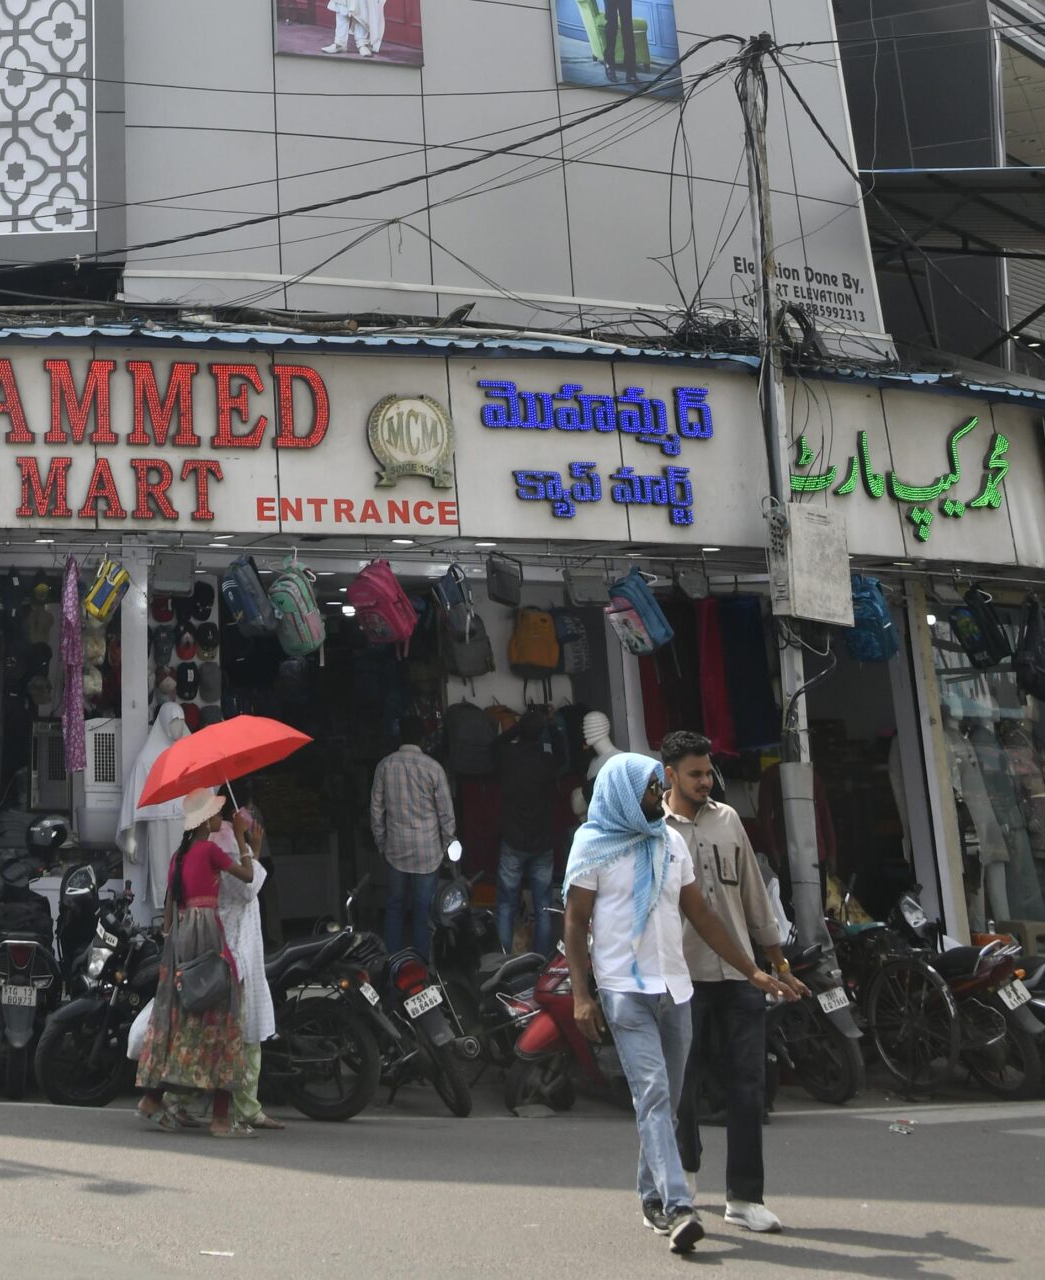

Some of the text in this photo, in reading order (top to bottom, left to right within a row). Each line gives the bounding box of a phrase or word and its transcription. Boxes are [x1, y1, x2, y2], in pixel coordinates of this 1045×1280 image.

[804, 266, 838, 286] Done
[793, 286, 853, 306] ELEVATION
[386, 408, 440, 456] MCM
[391, 463, 417, 474] SINCE
[16, 457, 225, 521] MART
[256, 496, 459, 526] ENTRANCE
